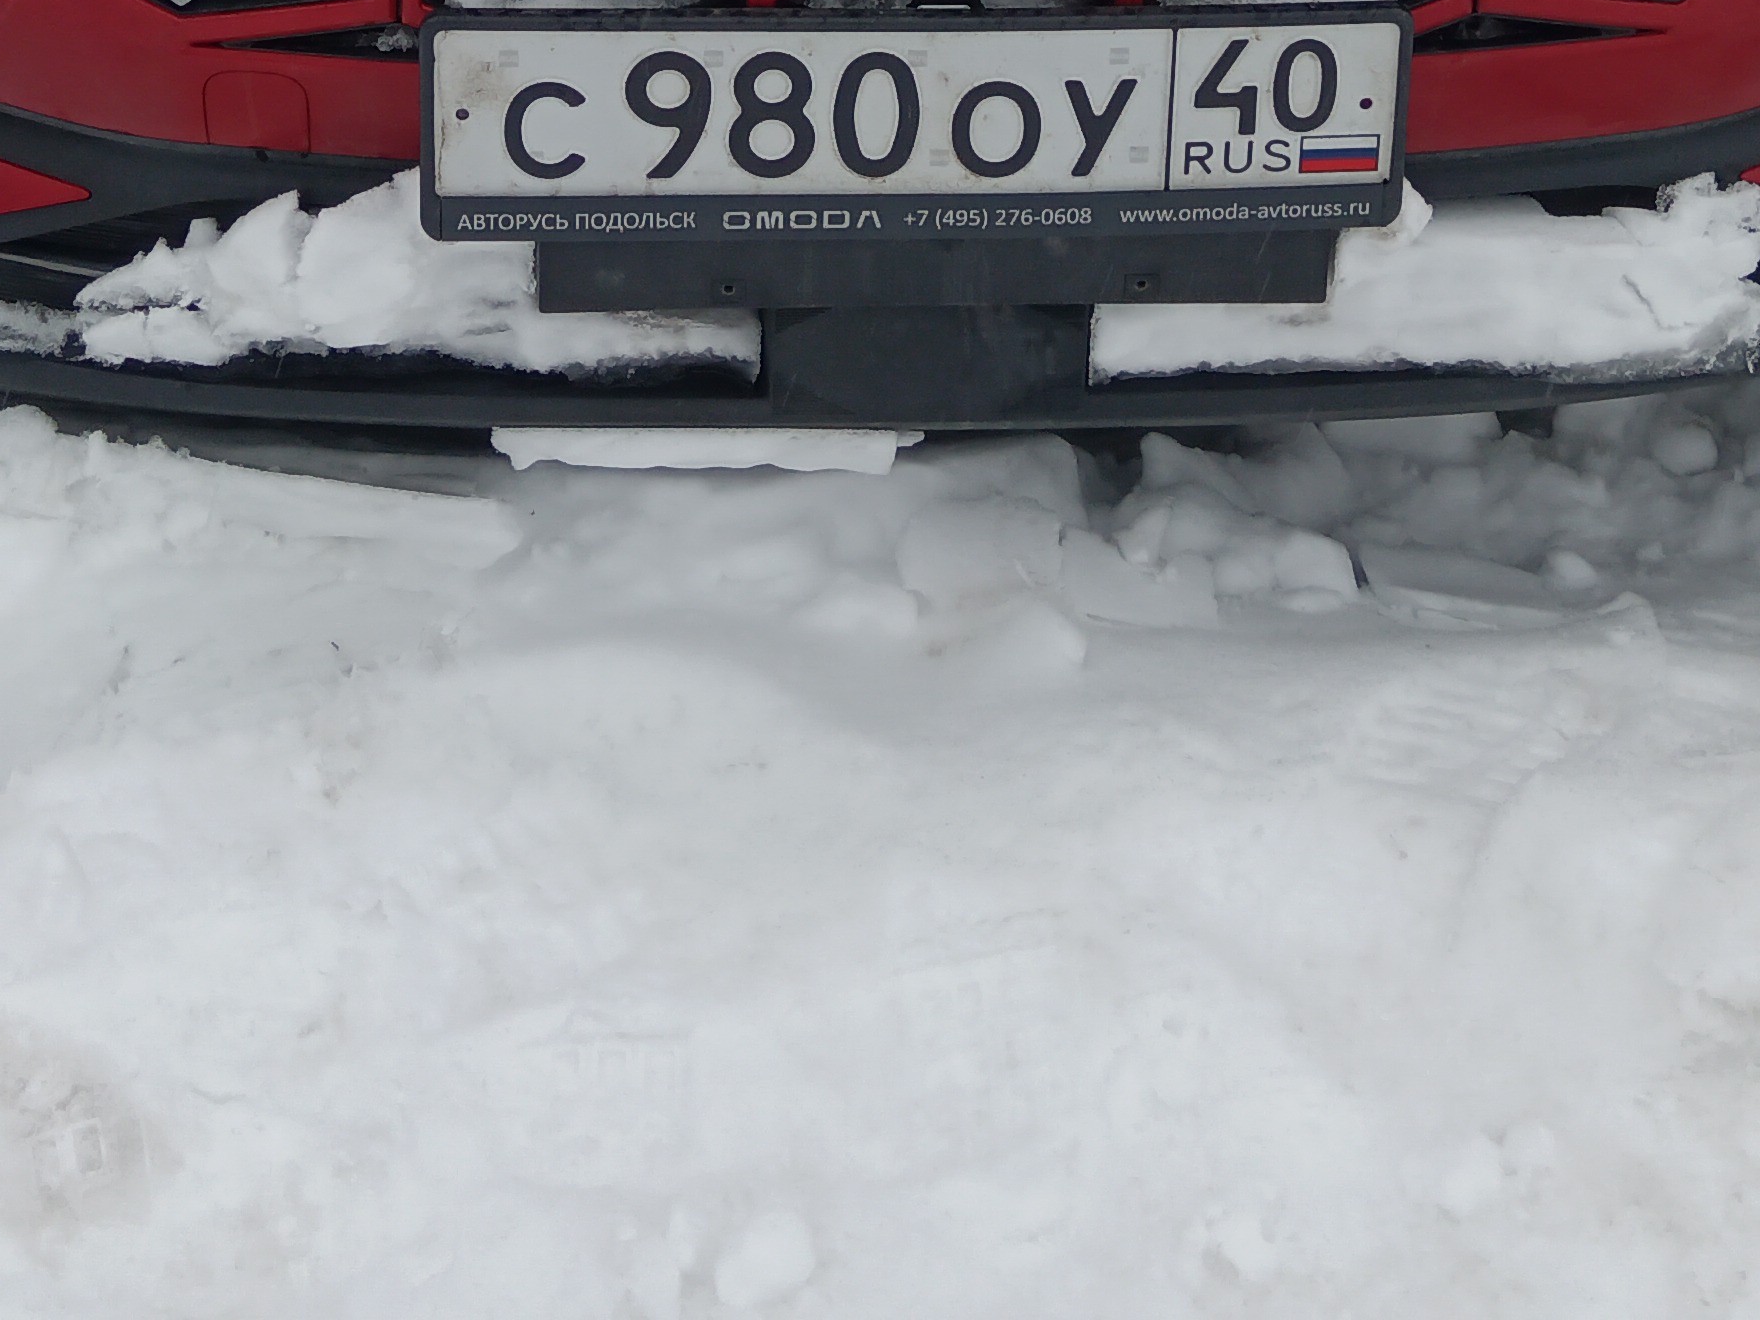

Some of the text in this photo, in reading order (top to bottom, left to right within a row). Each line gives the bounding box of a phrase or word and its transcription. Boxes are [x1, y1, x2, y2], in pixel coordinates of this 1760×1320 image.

[1193, 38, 1338, 135] 40
[1183, 139, 1291, 175] RUS
[456, 212, 569, 232] АВТОРУСЬ
[575, 211, 696, 233] ПОДОЛЬСК
[902, 208, 929, 228] +7
[935, 207, 989, 230] (495)
[995, 207, 1093, 227] 276-0608
[1119, 200, 1371, 223] www.omoda-avtoruss.ru
